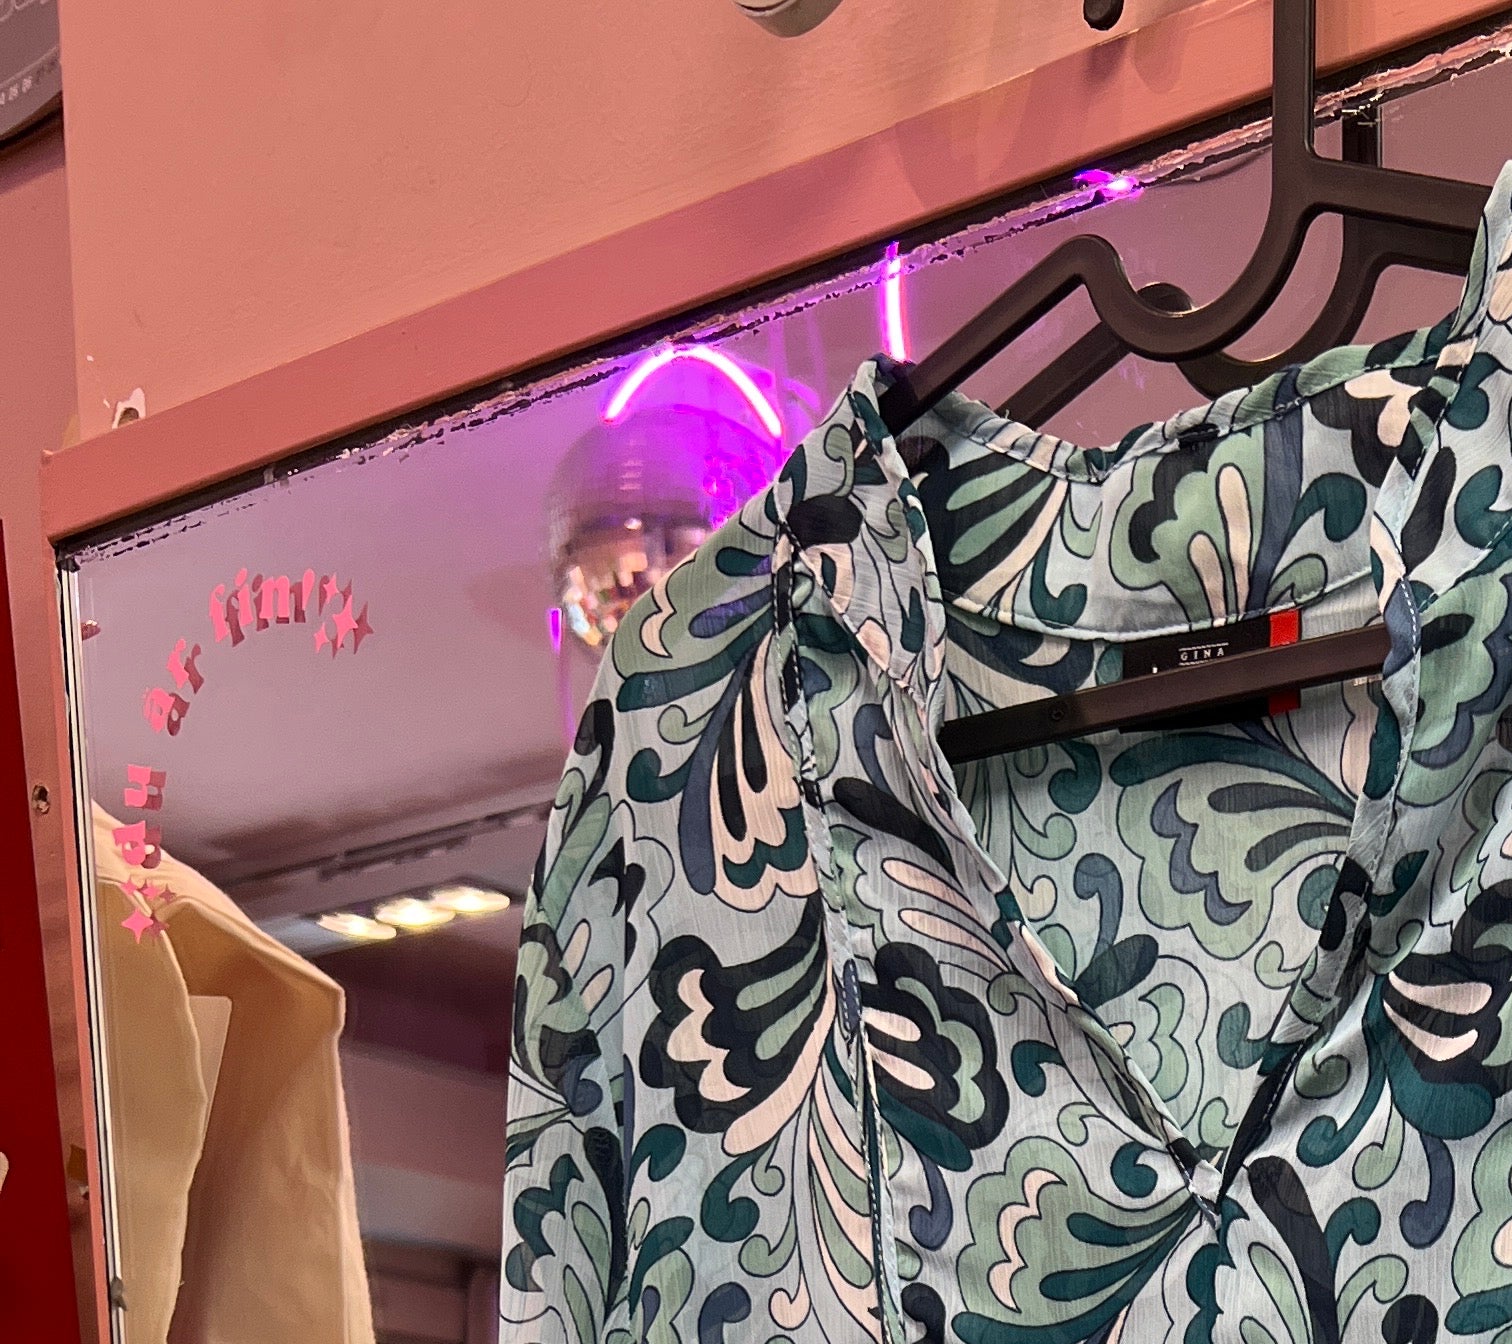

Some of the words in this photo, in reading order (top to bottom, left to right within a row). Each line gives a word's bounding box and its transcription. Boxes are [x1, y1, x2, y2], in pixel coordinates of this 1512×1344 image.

[113, 765, 151, 865] du
[209, 567, 315, 643] fin!
[1180, 647, 1225, 662] GINA
